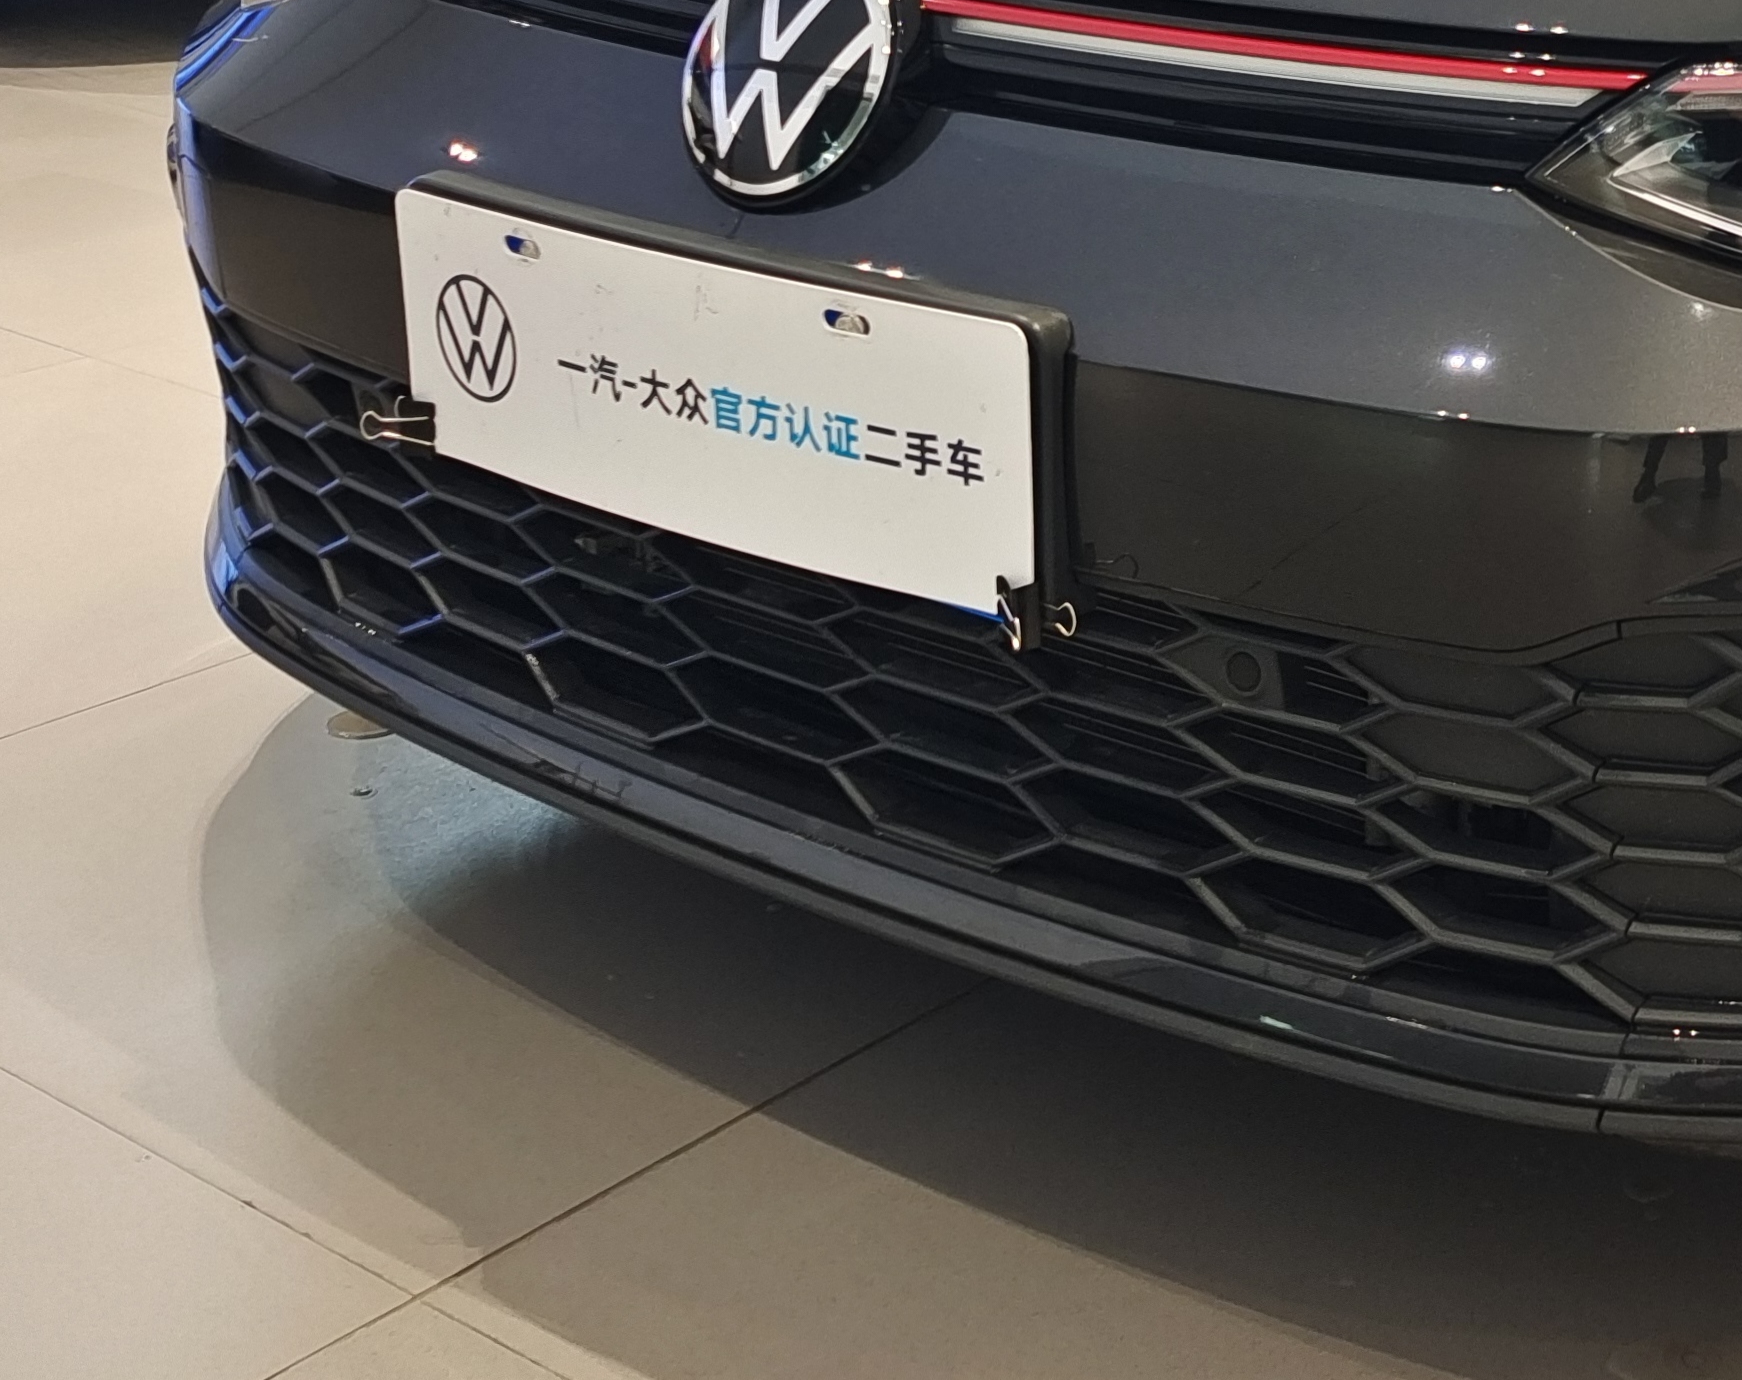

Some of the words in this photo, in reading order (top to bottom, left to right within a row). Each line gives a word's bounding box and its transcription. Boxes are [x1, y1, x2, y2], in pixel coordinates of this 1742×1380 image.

[557, 353, 985, 486] 一汽-大众官方认证二手车
